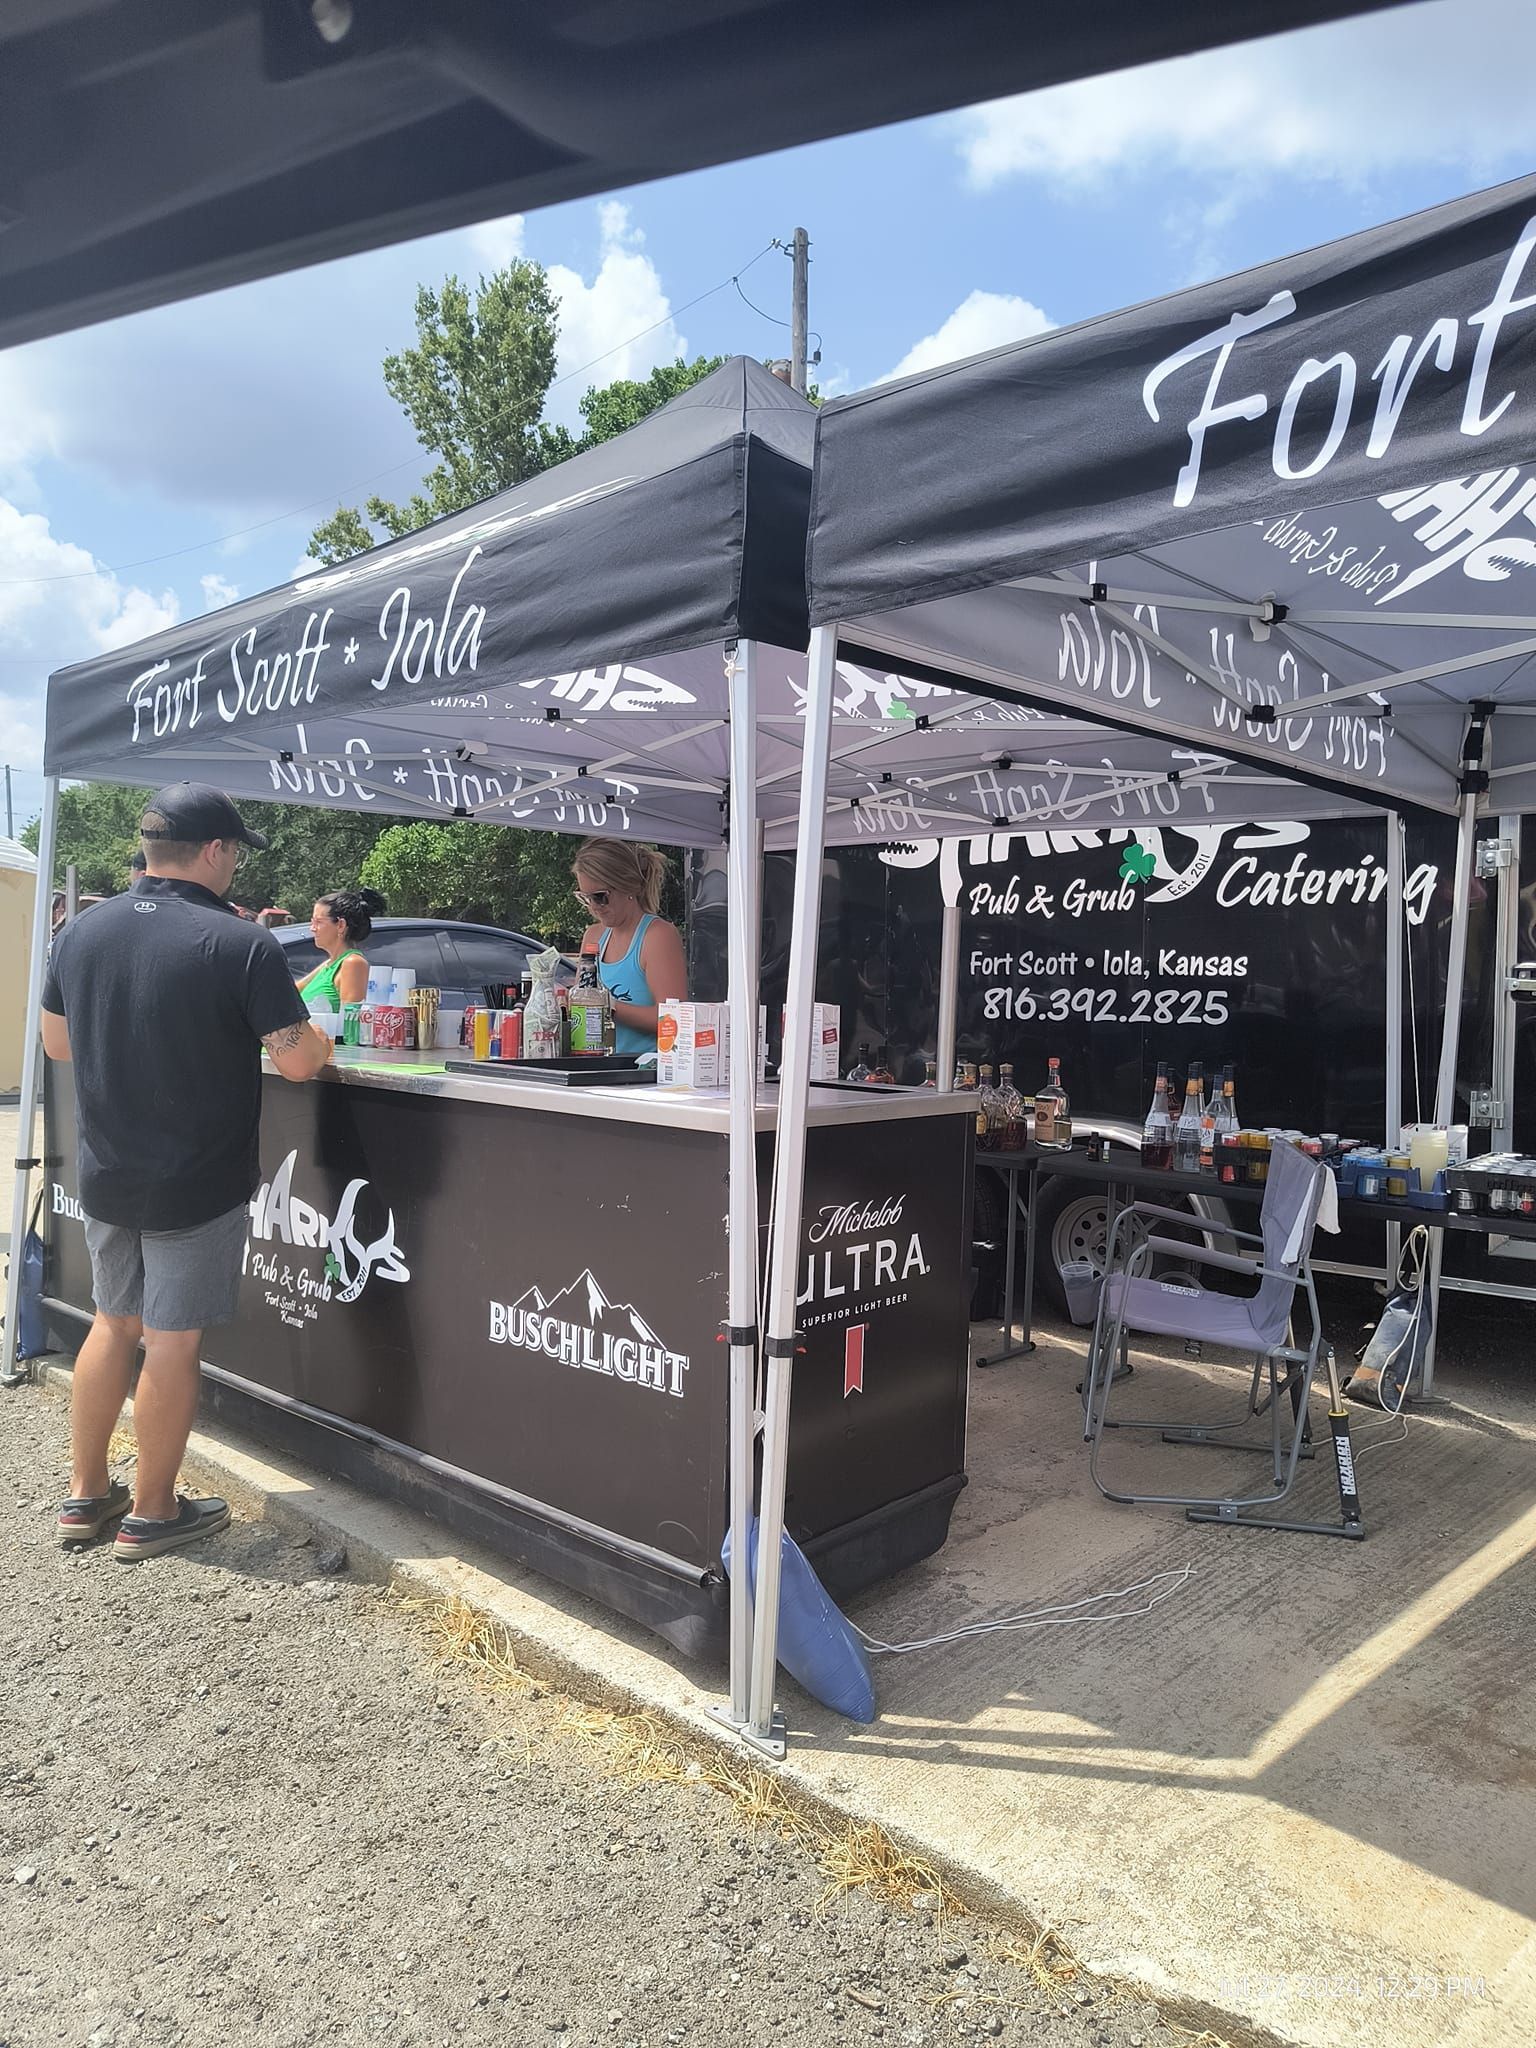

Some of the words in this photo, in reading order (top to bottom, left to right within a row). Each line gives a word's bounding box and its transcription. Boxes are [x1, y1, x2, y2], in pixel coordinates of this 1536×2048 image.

[1142, 215, 1536, 508] Fort
[127, 648, 216, 742] Fort
[217, 607, 335, 723] Scott
[371, 545, 487, 690] Iola
[1190, 853, 1211, 878] 2011
[1216, 851, 1439, 926] Catering
[969, 875, 1021, 915] Pub
[1025, 884, 1055, 919] &
[1062, 869, 1136, 918] Grub
[970, 951, 1013, 976] Fort
[1018, 951, 1078, 976] Scott
[1158, 949, 1248, 977] Kansas
[983, 986, 1229, 1026] 816.392.2825
[808, 1193, 907, 1243] Michelob
[252, 1252, 279, 1282] Pub
[280, 1265, 294, 1293] &
[297, 1267, 332, 1302] Grub
[796, 1233, 927, 1306] ULTRA
[265, 1291, 280, 1307] Fort
[280, 1296, 297, 1312] Scott
[801, 1308, 850, 1328] SUPERIOR
[854, 1299, 882, 1315] LIGHT
[886, 1293, 908, 1306] BEER
